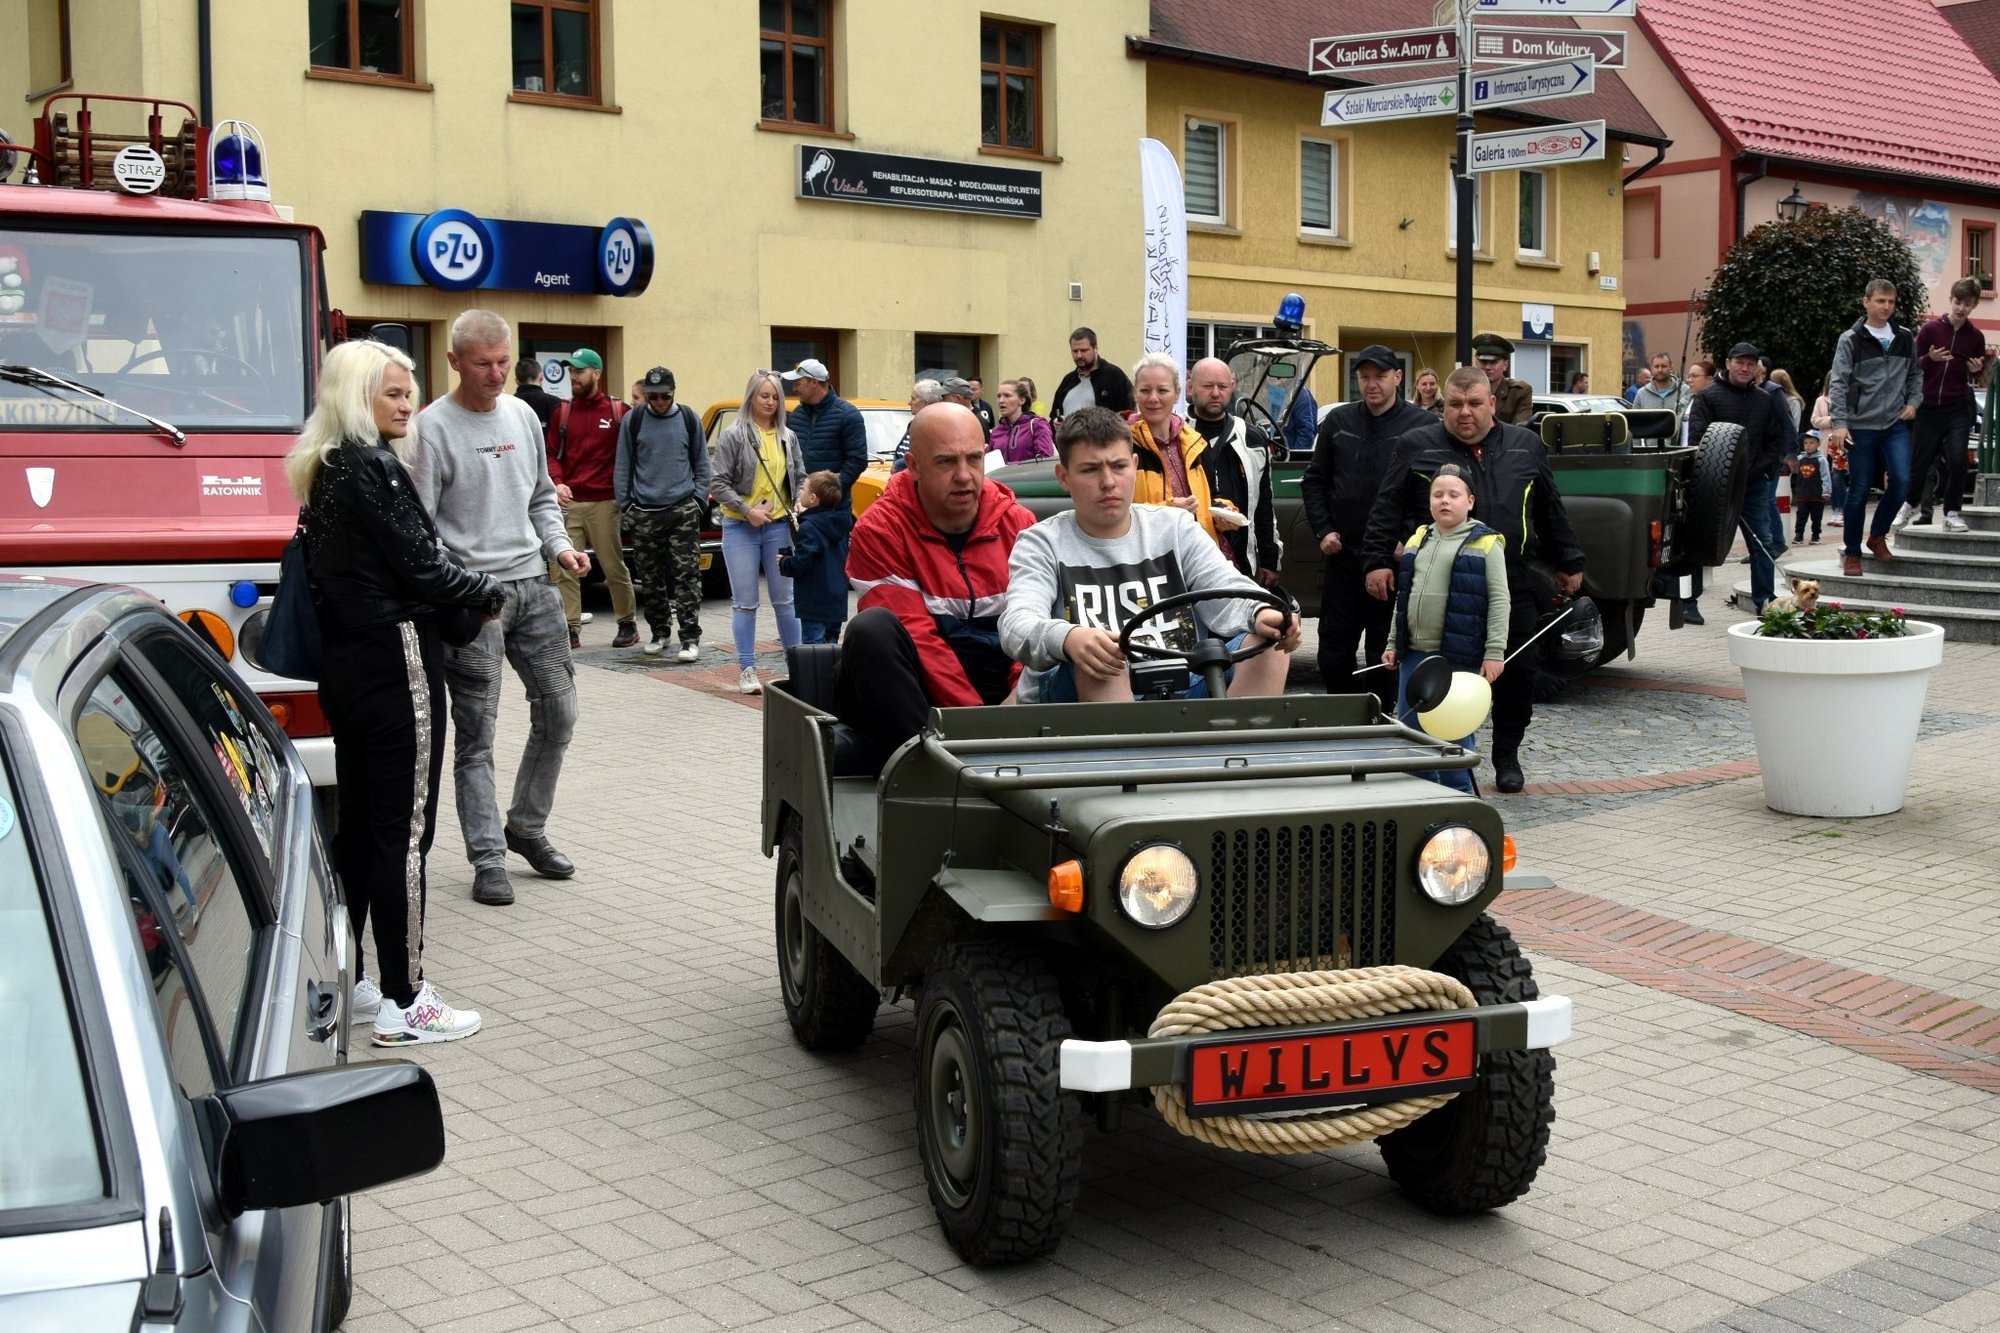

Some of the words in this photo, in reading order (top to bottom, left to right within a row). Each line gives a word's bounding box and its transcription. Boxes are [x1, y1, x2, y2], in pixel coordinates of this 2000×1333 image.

[1336, 46, 1378, 66] Kaplica
[1512, 38, 1543, 55] Dom
[1546, 40, 1591, 57] Kultury
[1494, 77, 1527, 96] Informacja
[1528, 75, 1565, 94] Turystyczna
[1345, 99, 1365, 116] Szlaki
[1474, 144, 1505, 162] Galeria
[1507, 149, 1527, 158] 100m
[832, 177, 868, 194] Vitalis
[872, 170, 925, 185] REHABILITACJA
[929, 176, 954, 188] MASAŻ
[959, 180, 1007, 193] MODELOWANIE
[1008, 184, 1041, 196] SYLWETKI
[890, 185, 954, 200] REFLEKSOTERAPIA
[958, 192, 995, 204] MEDYCYNA
[995, 194, 1024, 207] CHIŃSKA
[435, 232, 478, 269] PZU
[607, 239, 631, 275] PZU
[534, 271, 570, 288] Agent
[475, 446, 497, 454] TOMMY
[497, 444, 516, 452] JEANS
[202, 486, 263, 496] RATOWNIK
[1075, 574, 1180, 636] RISE
[1219, 1028, 1450, 1099] WILLYS
